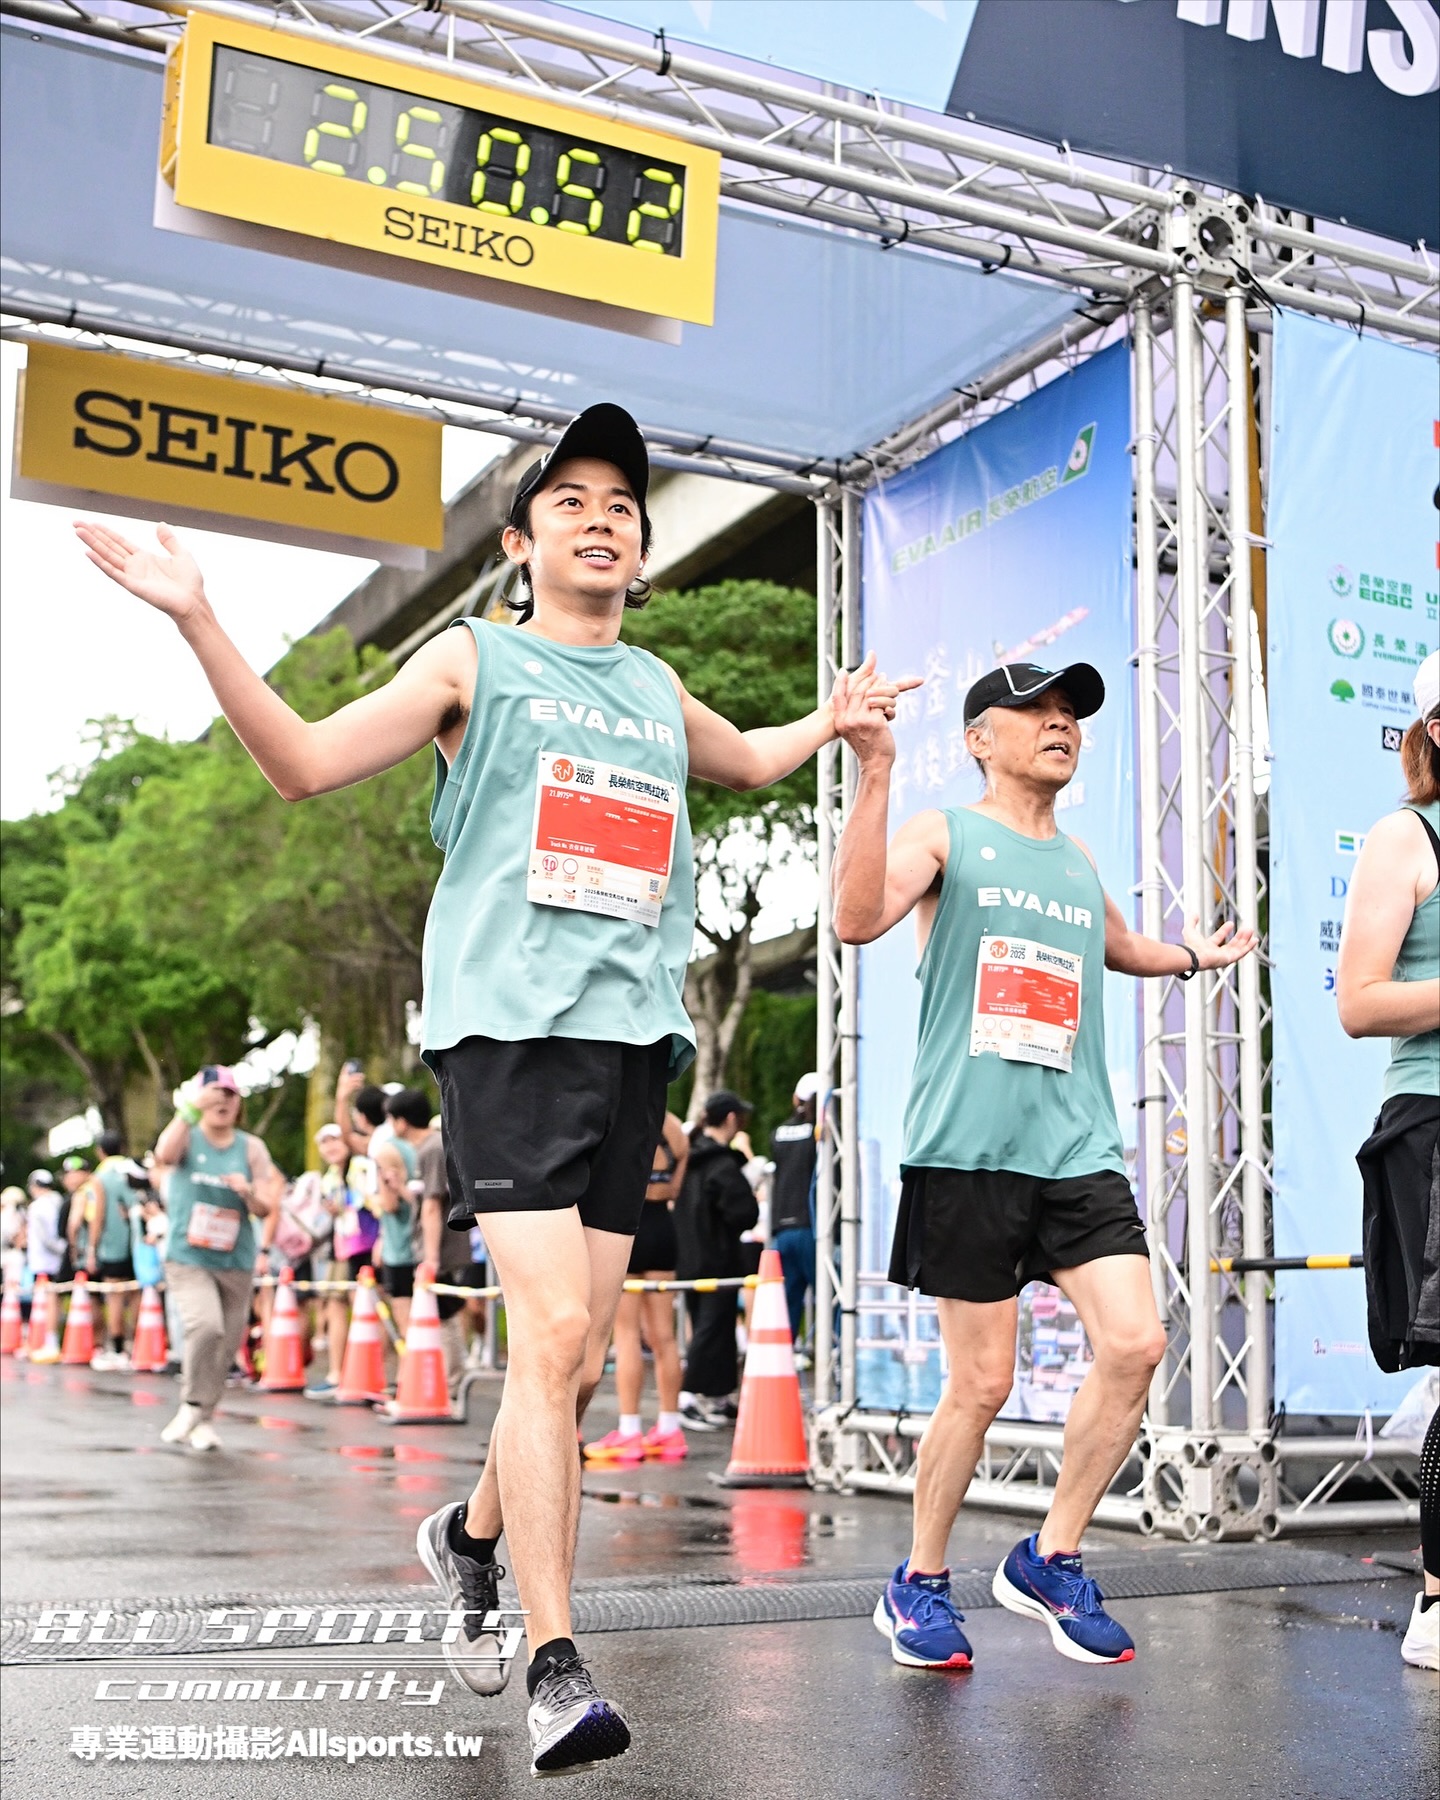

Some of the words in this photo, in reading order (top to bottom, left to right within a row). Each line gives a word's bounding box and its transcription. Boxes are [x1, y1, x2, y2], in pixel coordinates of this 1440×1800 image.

[384, 206, 535, 267] SEIKO
[73, 388, 400, 504] SEIKO
[986, 465, 1060, 526] 長榮航空
[1358, 586, 1413, 610] EGSC
[1372, 650, 1417, 665] EVERGREEN
[1361, 683, 1417, 706] 國泰世華
[575, 771, 595, 786] 2025
[608, 773, 670, 803] 長榮航空馬拉松
[1010, 949, 1026, 960] 2025
